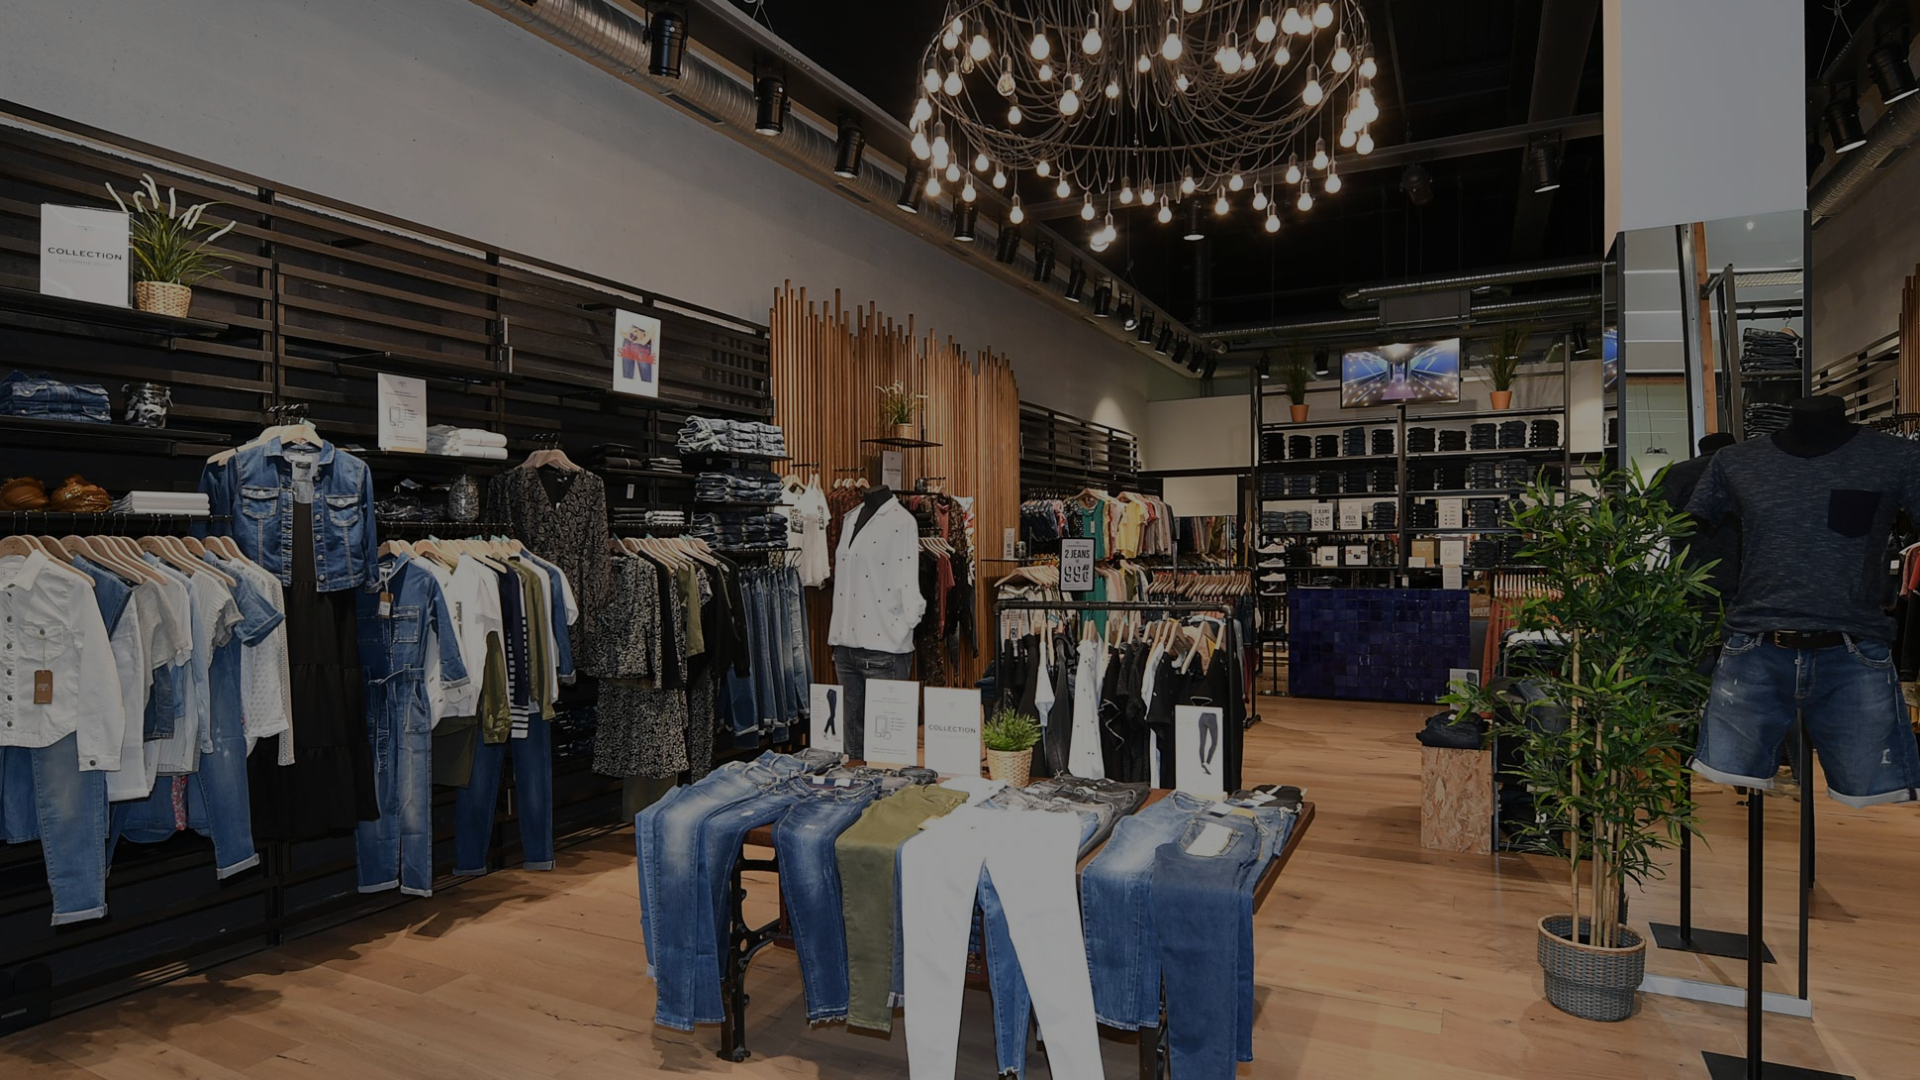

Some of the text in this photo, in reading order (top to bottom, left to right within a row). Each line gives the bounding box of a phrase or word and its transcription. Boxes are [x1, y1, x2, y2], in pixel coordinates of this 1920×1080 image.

[47, 246, 122, 261] COLLECTION
[1064, 549, 1091, 559] 2 JEANS
[928, 723, 977, 734] COLLECTION
